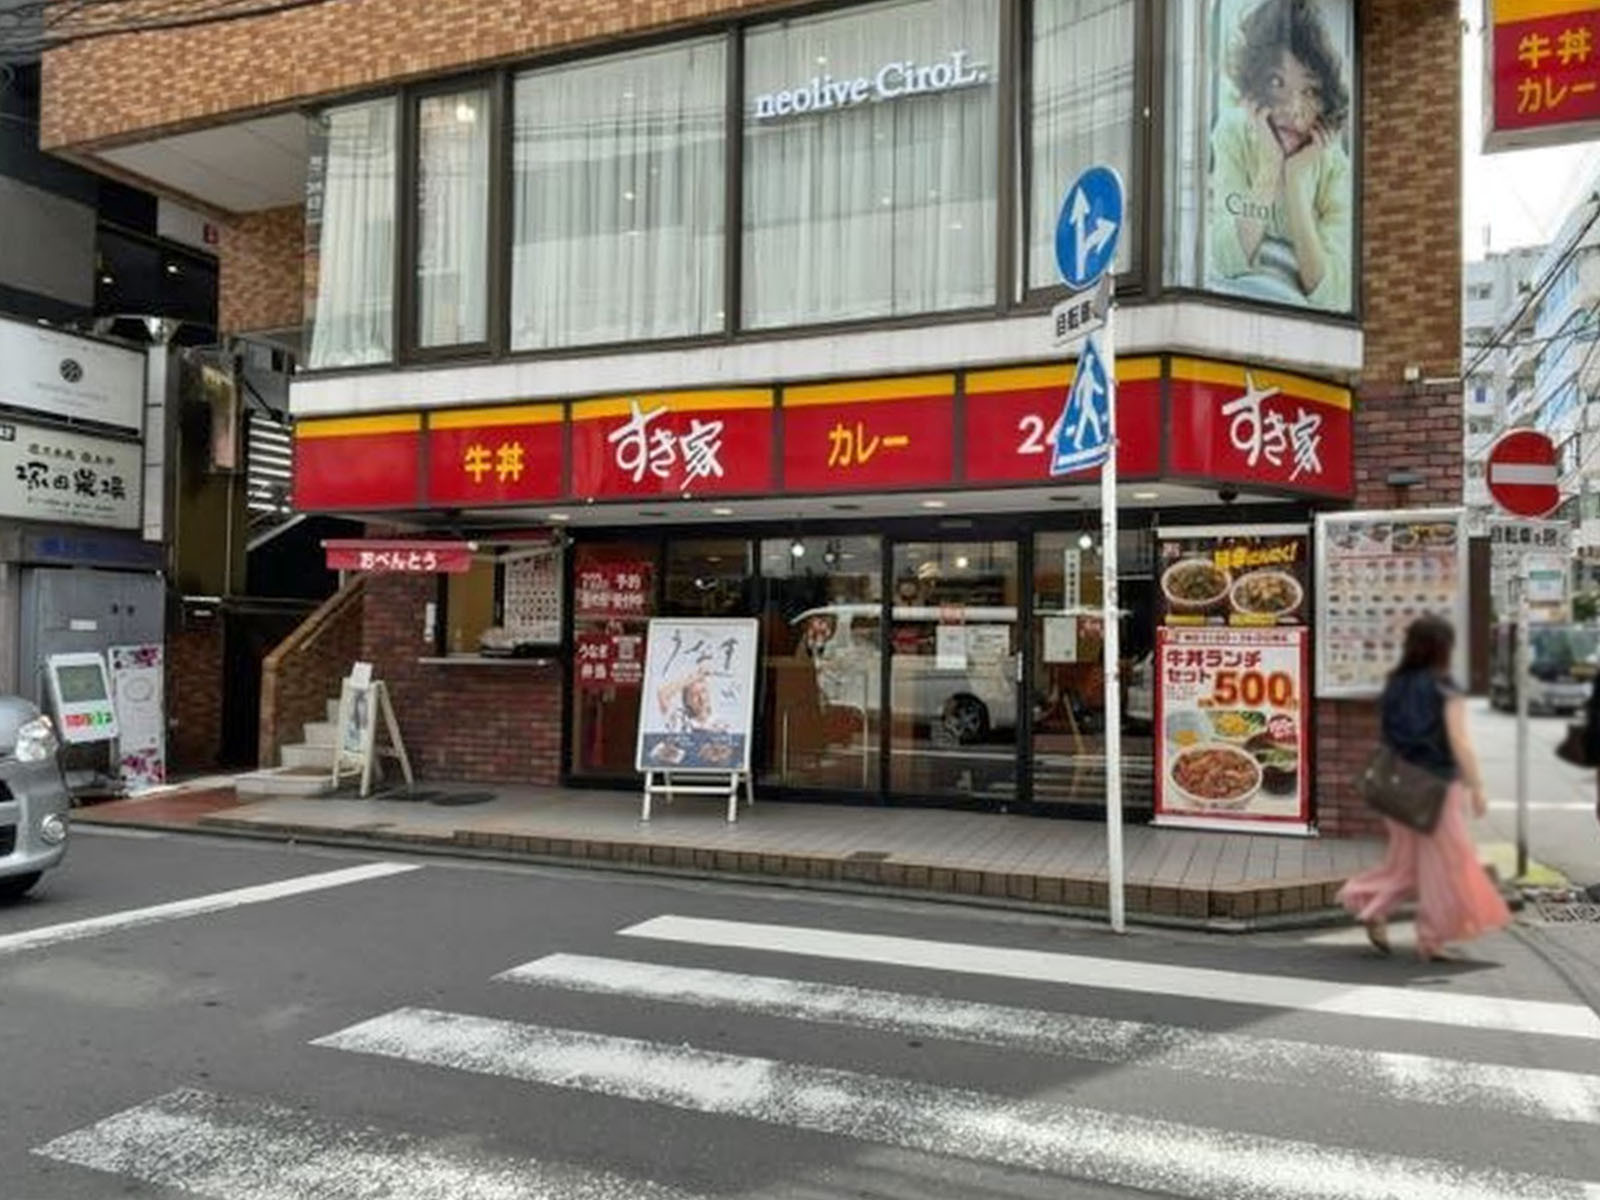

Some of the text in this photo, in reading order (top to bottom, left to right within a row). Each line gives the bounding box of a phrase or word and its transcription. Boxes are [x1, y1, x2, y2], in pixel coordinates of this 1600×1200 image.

[1518, 27, 1592, 69] 牛丼
[755, 76, 869, 117] neolive
[1518, 76, 1597, 114] カレー
[1056, 300, 1100, 337] 自転車
[608, 399, 724, 490] すき家
[828, 421, 909, 467] カレー
[1222, 371, 1322, 481] すき家
[464, 442, 524, 483] 牛丼
[360, 551, 437, 571] おべんとう
[1165, 650, 1262, 668] 牛丼ランチ
[1167, 668, 1212, 684] セット
